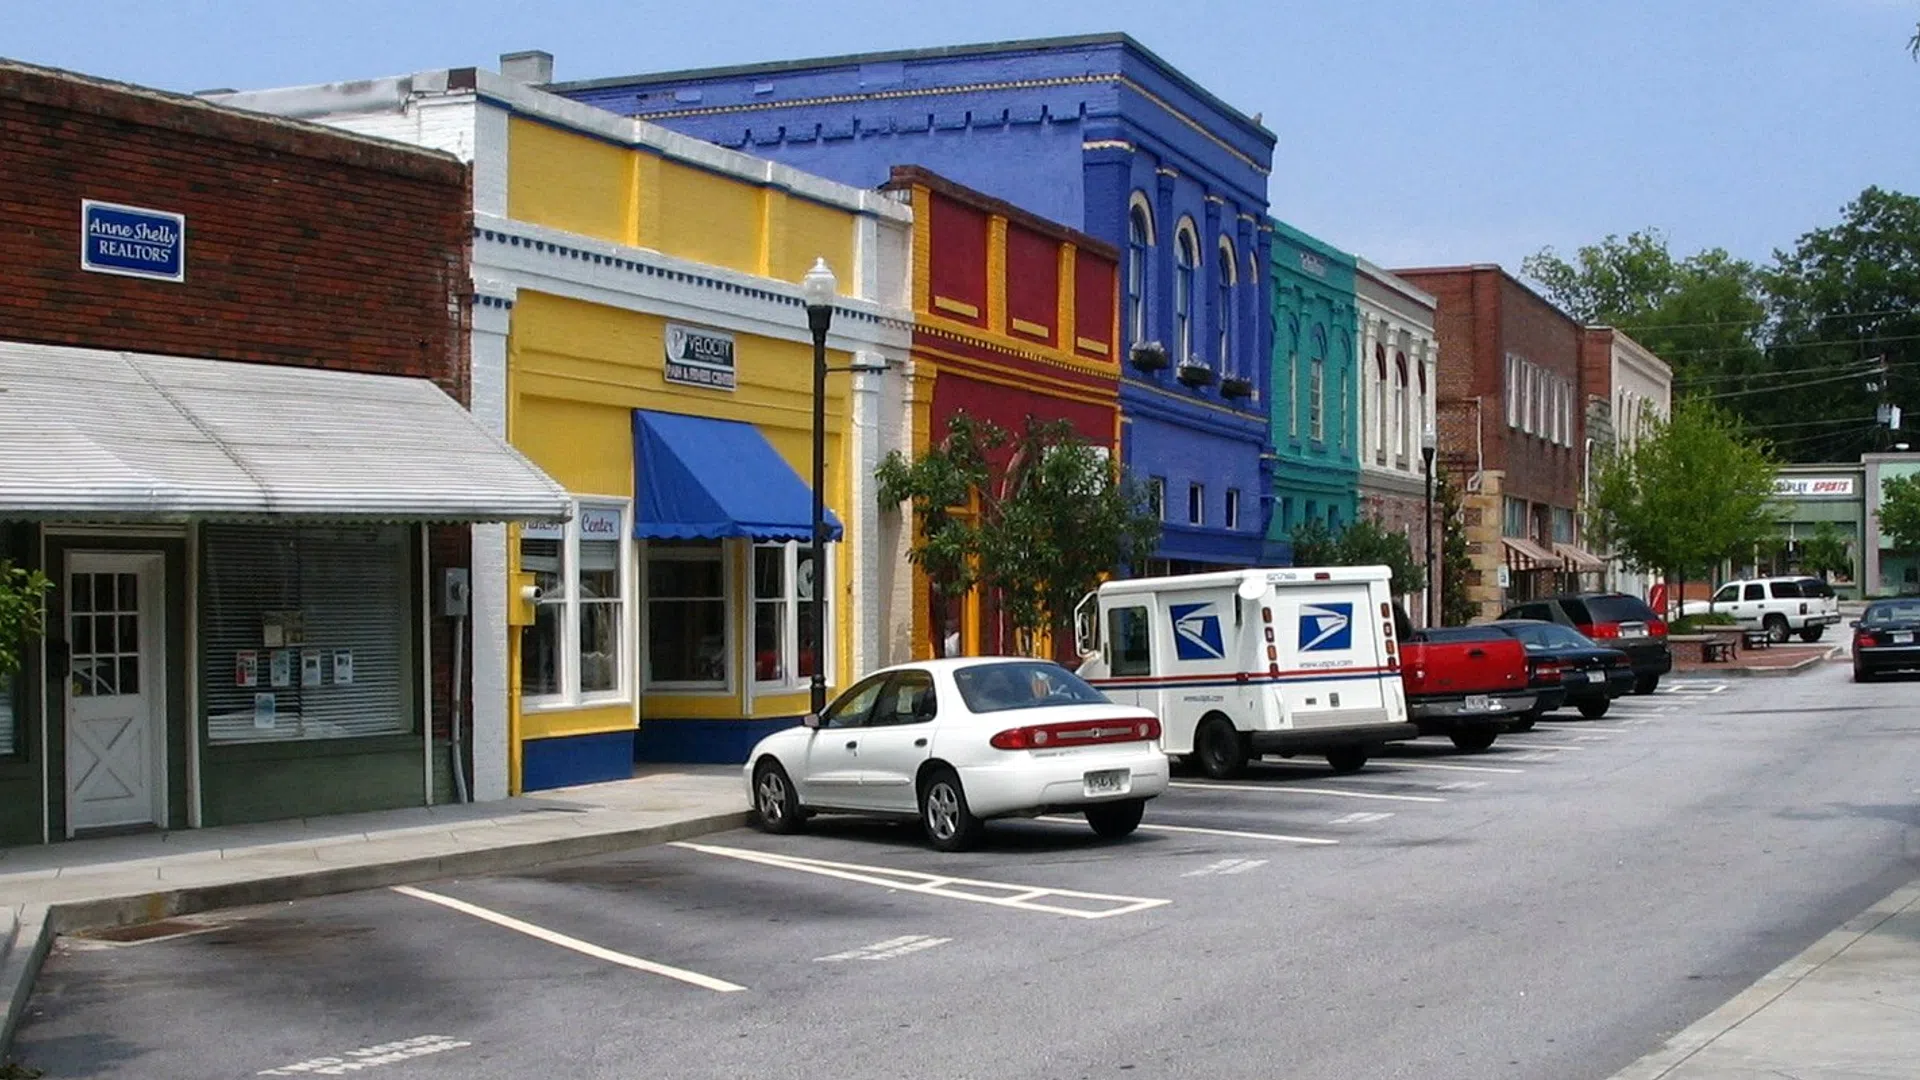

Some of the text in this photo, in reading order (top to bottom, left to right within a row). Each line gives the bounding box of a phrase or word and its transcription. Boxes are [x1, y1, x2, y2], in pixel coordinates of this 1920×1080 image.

[90, 218, 178, 248] Anne Shelly
[99, 240, 172, 263] REALTORS
[688, 335, 730, 357] VELOCITY
[1812, 481, 1849, 492] SPORTS
[581, 513, 614, 533] Center
